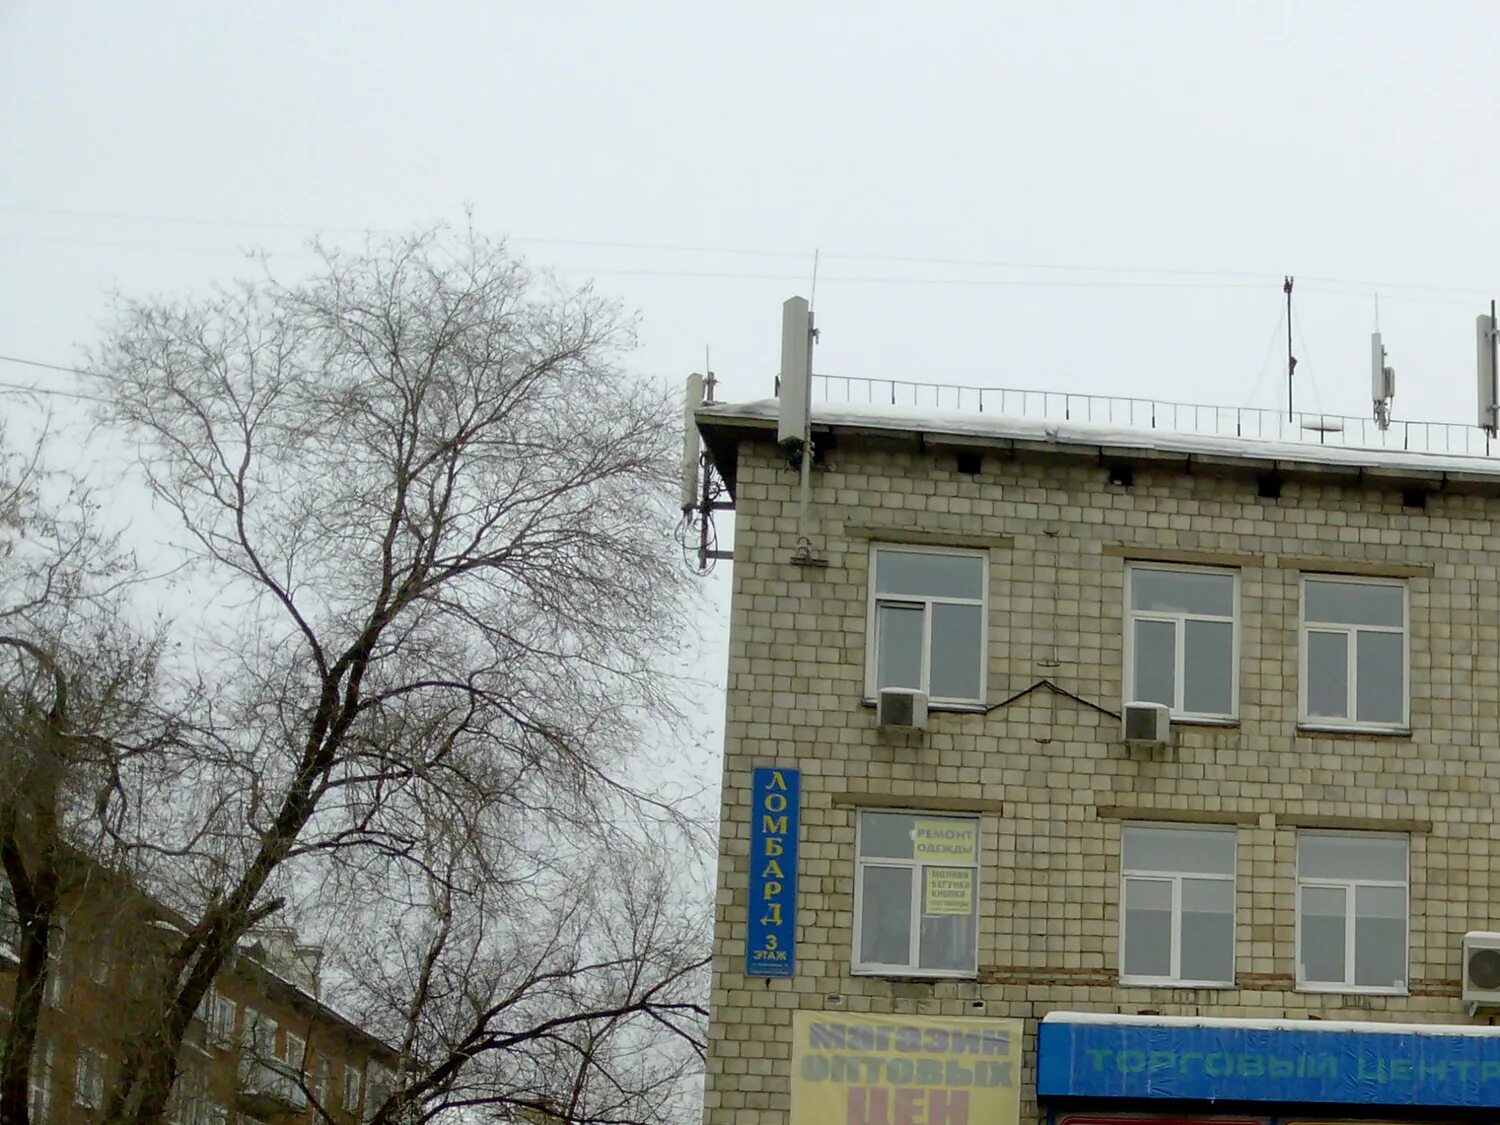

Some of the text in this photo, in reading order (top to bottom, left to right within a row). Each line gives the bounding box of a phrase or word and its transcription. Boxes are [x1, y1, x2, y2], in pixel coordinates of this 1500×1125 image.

[917, 829, 973, 840] РЕМОНТ
[760, 771, 788, 926] ЛОМБАРД
[917, 843, 973, 854] ОДЕЖДЫ
[765, 934, 778, 950] 3
[753, 950, 788, 961] ЭТАЖ
[1086, 1047, 1339, 1081] ТОРГОВЫЙ
